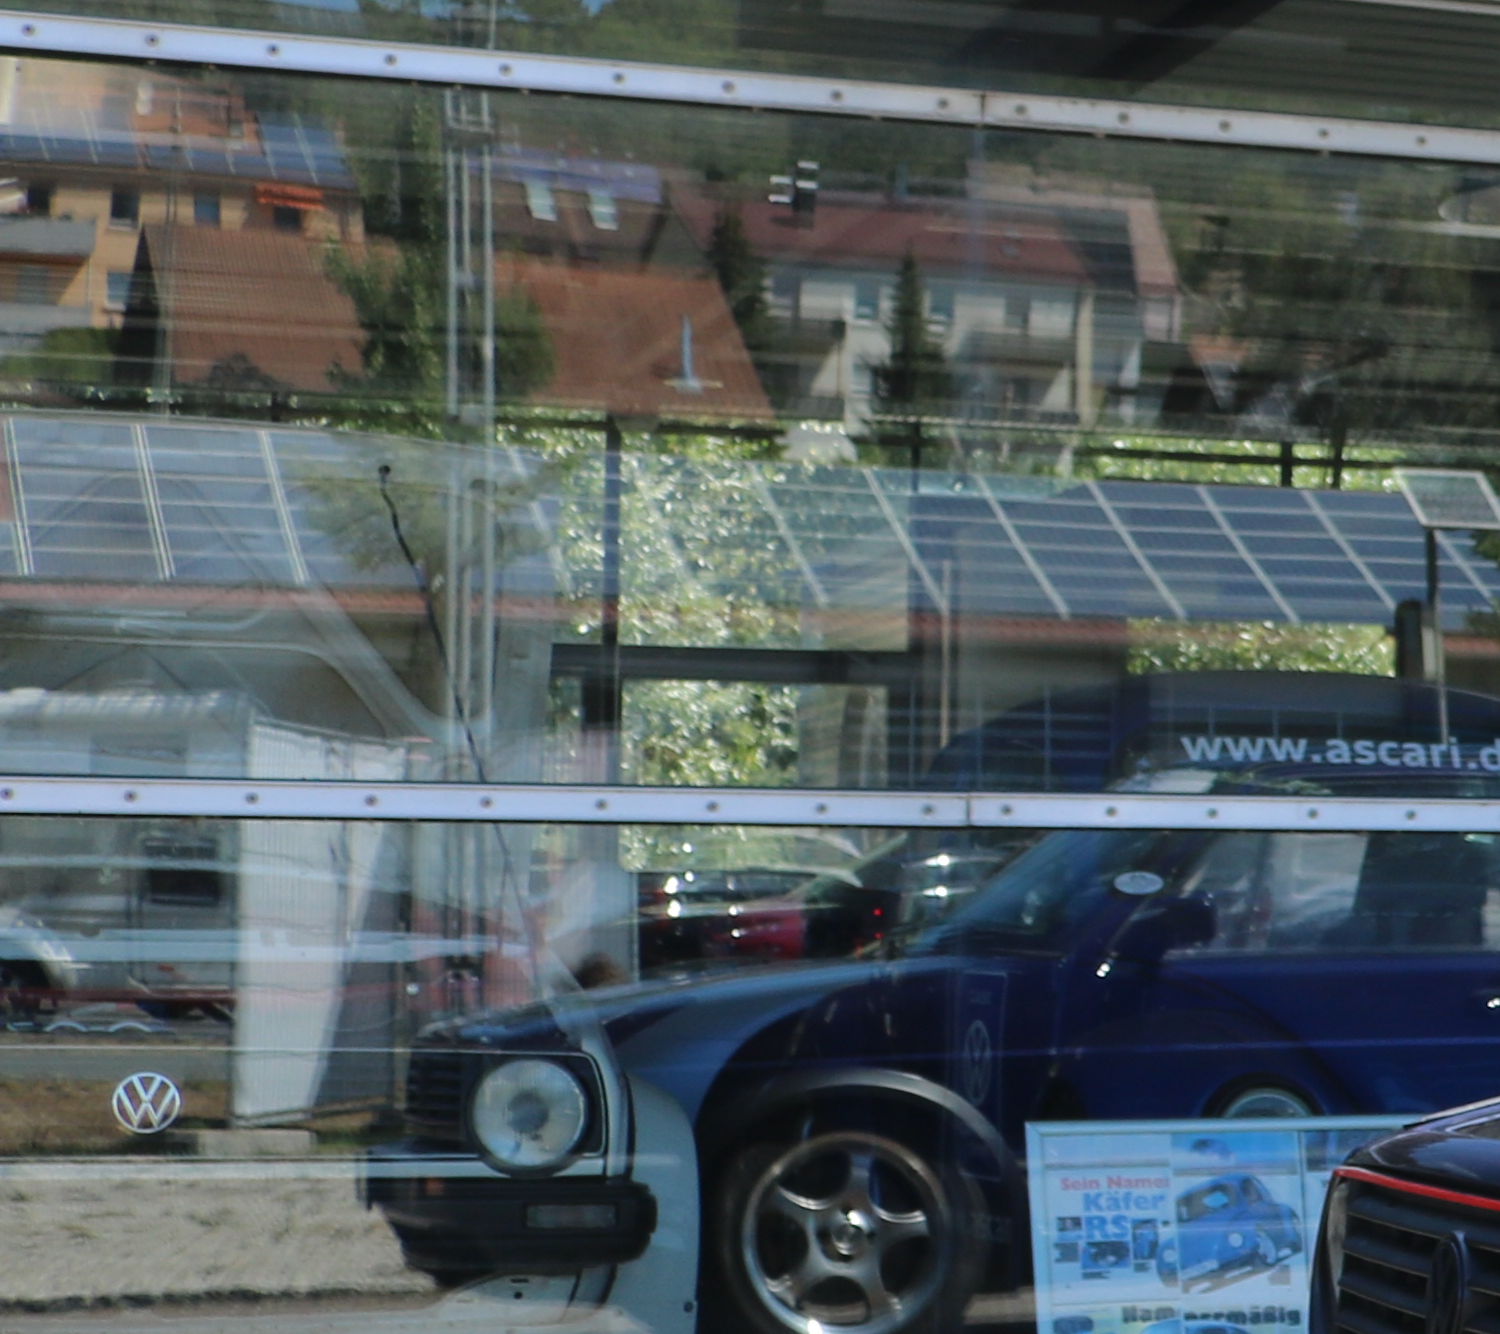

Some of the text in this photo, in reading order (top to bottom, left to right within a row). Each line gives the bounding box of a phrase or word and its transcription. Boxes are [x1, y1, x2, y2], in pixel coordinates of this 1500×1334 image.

[1061, 1177, 1100, 1191] Sein
[1083, 1191, 1165, 1212] Käfer
[1084, 1215, 1131, 1240] RS
